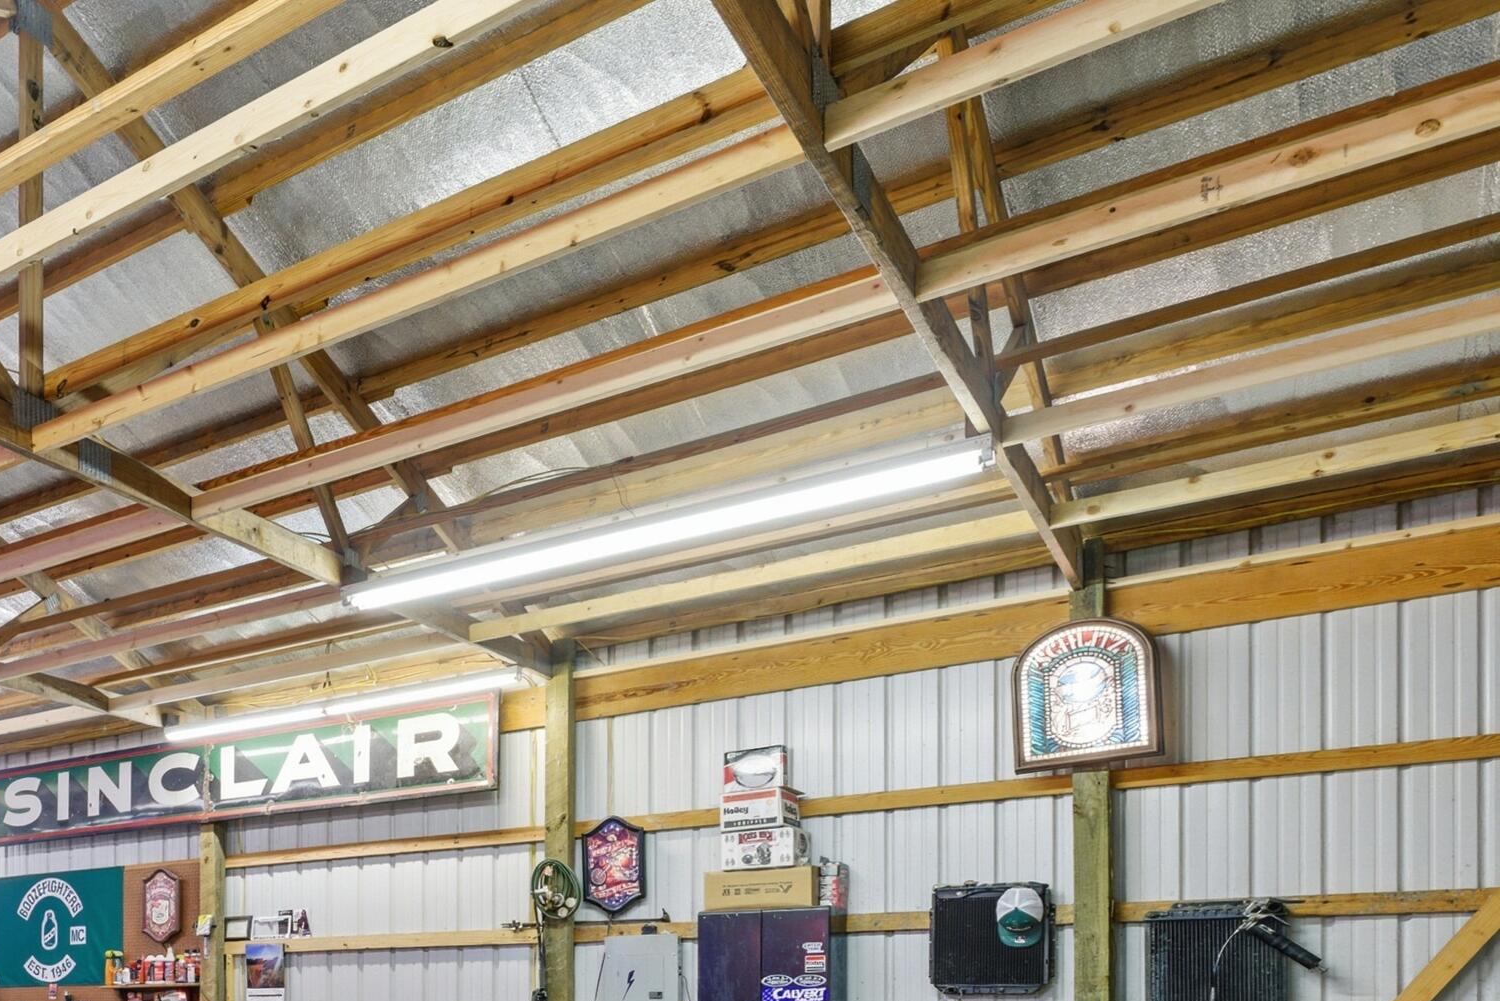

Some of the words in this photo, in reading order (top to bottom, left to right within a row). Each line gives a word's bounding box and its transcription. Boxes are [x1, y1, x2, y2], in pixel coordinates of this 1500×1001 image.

[2, 711, 461, 828] SINCLAIR
[723, 806, 749, 816] Holley
[18, 880, 82, 918] BOOZEFIGHTERS
[71, 929, 85, 942] MC
[27, 960, 48, 979] EST.
[51, 958, 73, 979] 1946
[772, 987, 827, 1001] CALVERT
